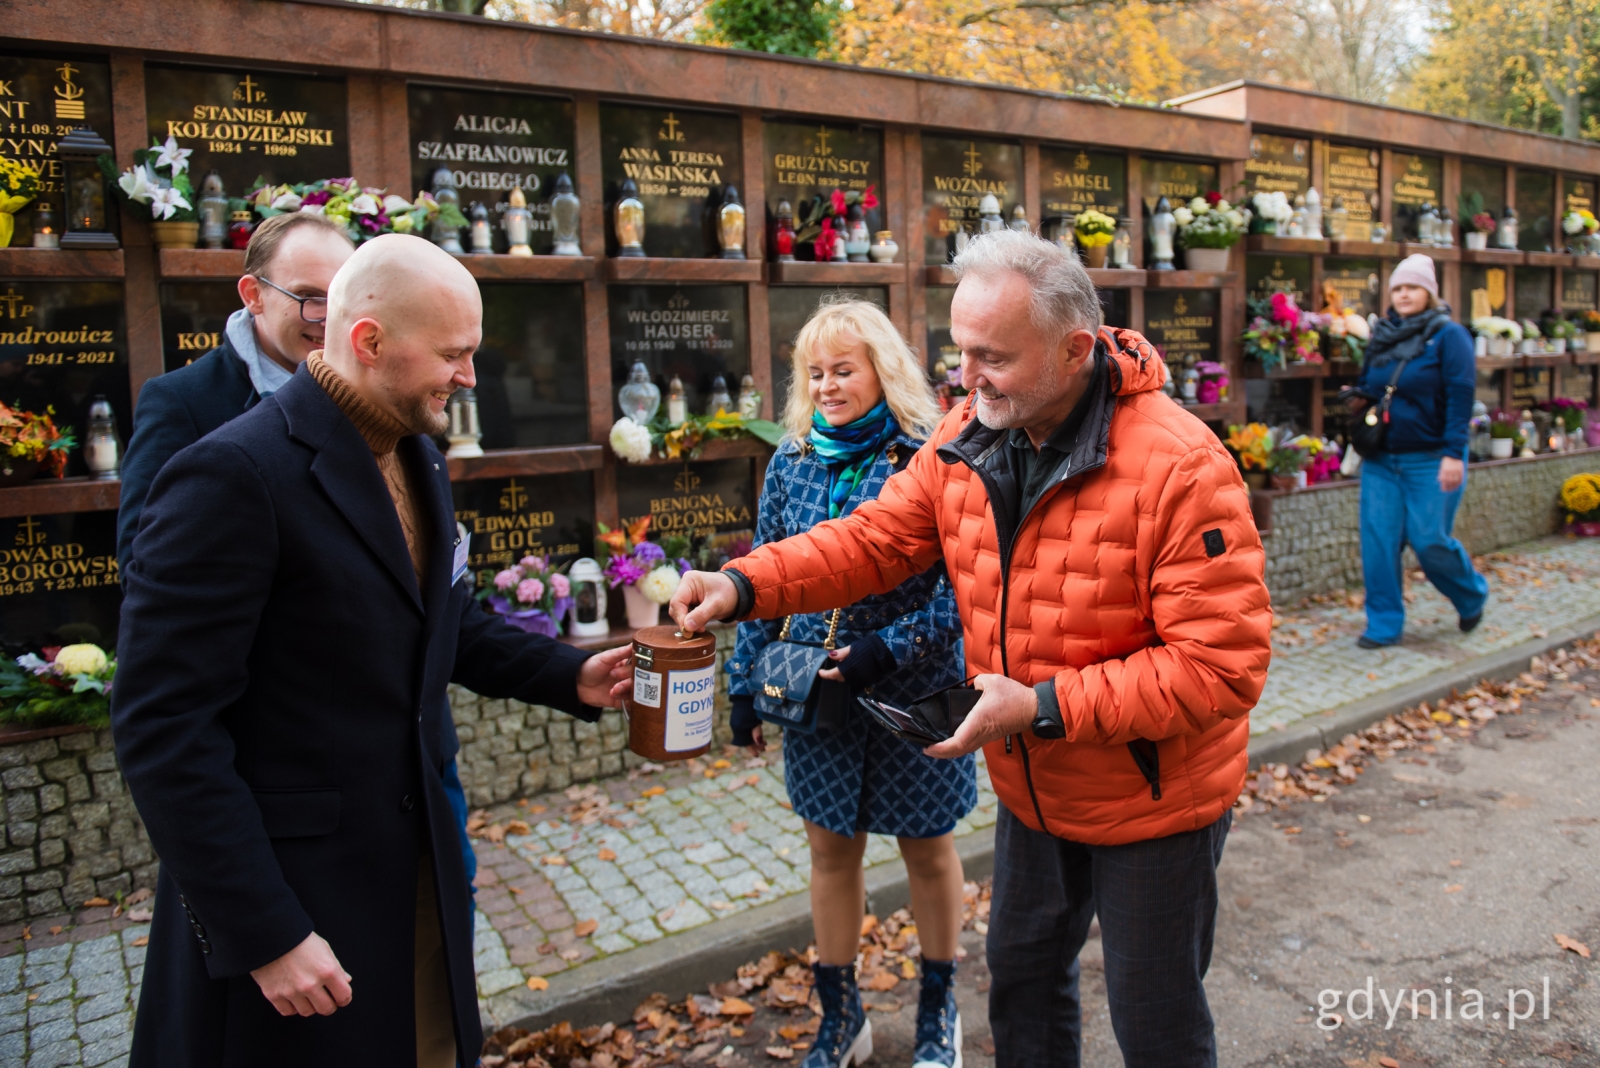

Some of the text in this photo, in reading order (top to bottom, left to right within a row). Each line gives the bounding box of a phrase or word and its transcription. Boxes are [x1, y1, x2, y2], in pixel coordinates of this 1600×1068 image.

[193, 104, 307, 126] STANISŁAW
[454, 114, 533, 135] ALICJA
[166, 120, 335, 146] KOŁODZIEJSKI
[208, 141, 242, 154] 1934
[264, 143, 298, 157] 1998
[418, 141, 569, 166] SZAFRANOWICZ
[619, 148, 725, 166] ANNA TERESA
[450, 169, 541, 192] OGIEGŁO
[622, 162, 722, 185] WASIŃSKA
[778, 171, 816, 187] LEON
[1052, 171, 1112, 191] SAMSEL
[1071, 190, 1095, 204] JAN
[626, 309, 730, 323] WŁODZIMIERZ
[0, 325, 114, 345] ndrowicz
[644, 323, 715, 339] HAUSER
[650, 493, 724, 513] BENIGNA
[473, 510, 555, 534] EDWARD
[490, 528, 543, 552] GOC
